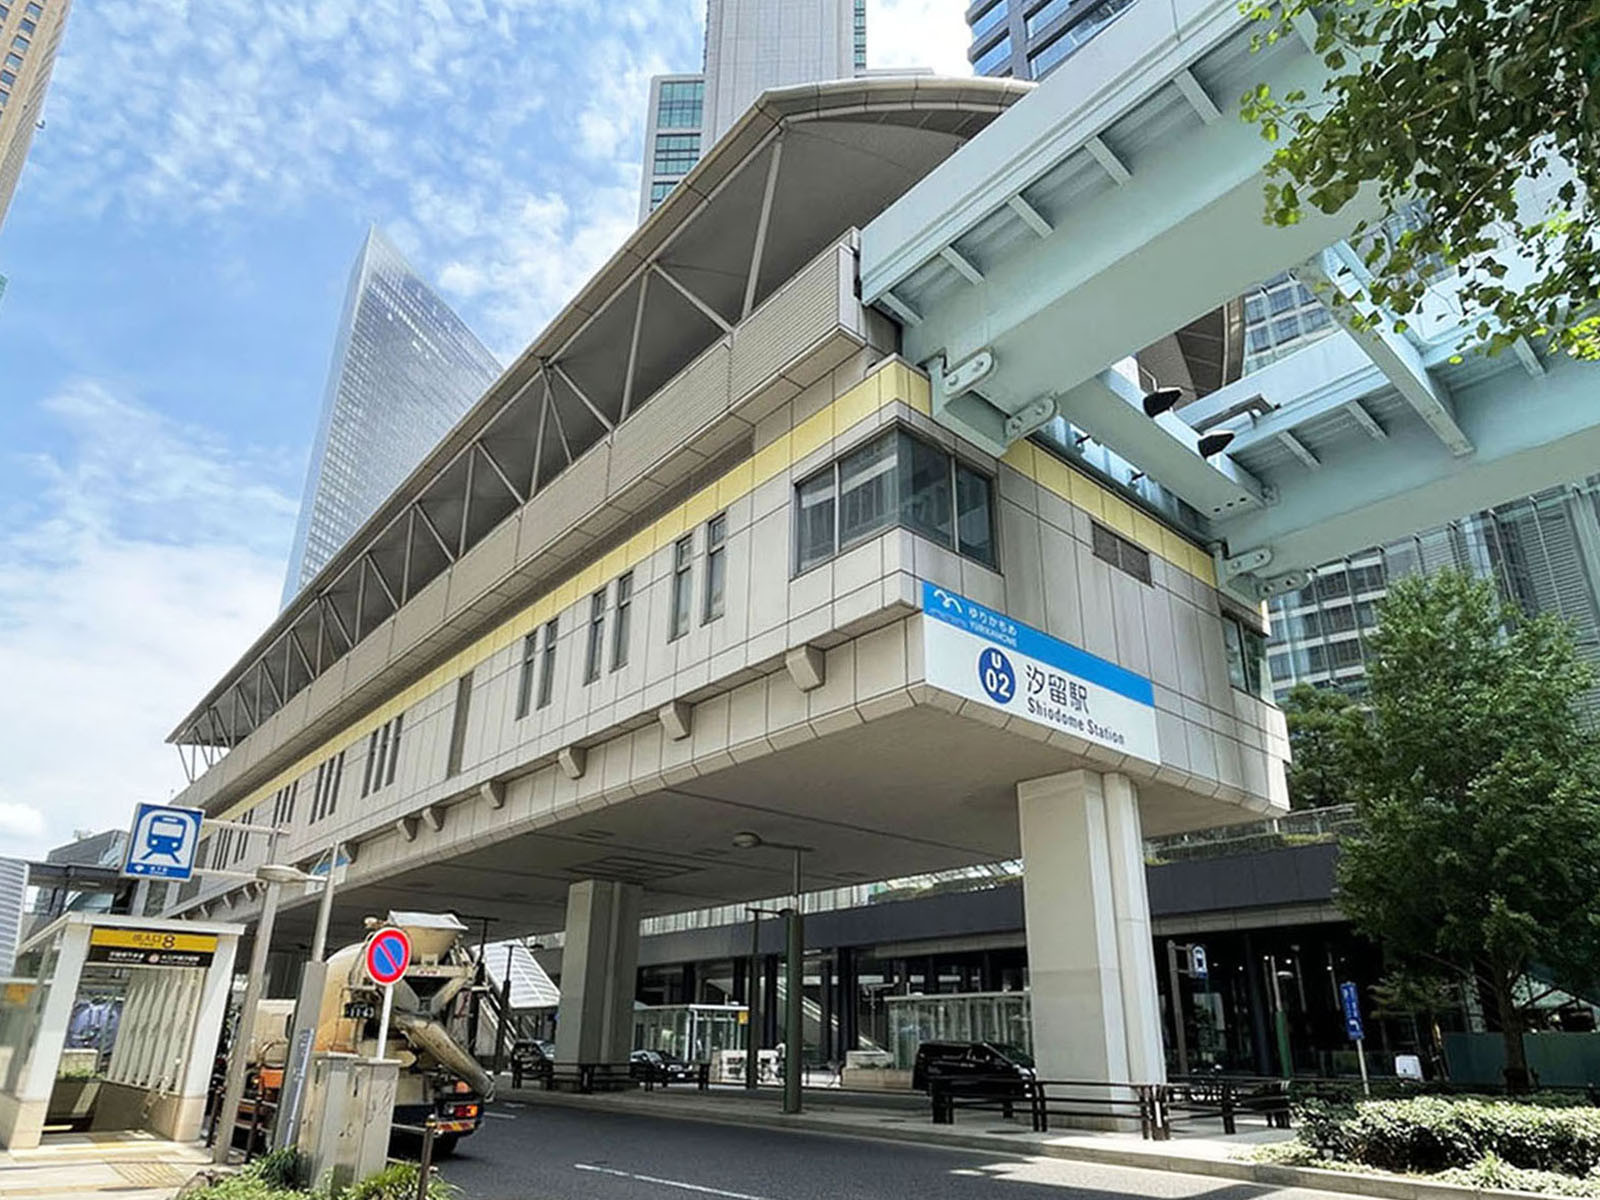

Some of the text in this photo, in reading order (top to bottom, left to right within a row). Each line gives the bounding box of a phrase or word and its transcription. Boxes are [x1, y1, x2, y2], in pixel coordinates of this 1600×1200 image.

[990, 651, 1002, 669] U
[985, 668, 1011, 698] 02
[1025, 663, 1089, 714] 汐留駅
[1027, 697, 1126, 745] Shiodome Station
[161, 934, 176, 950] 8
